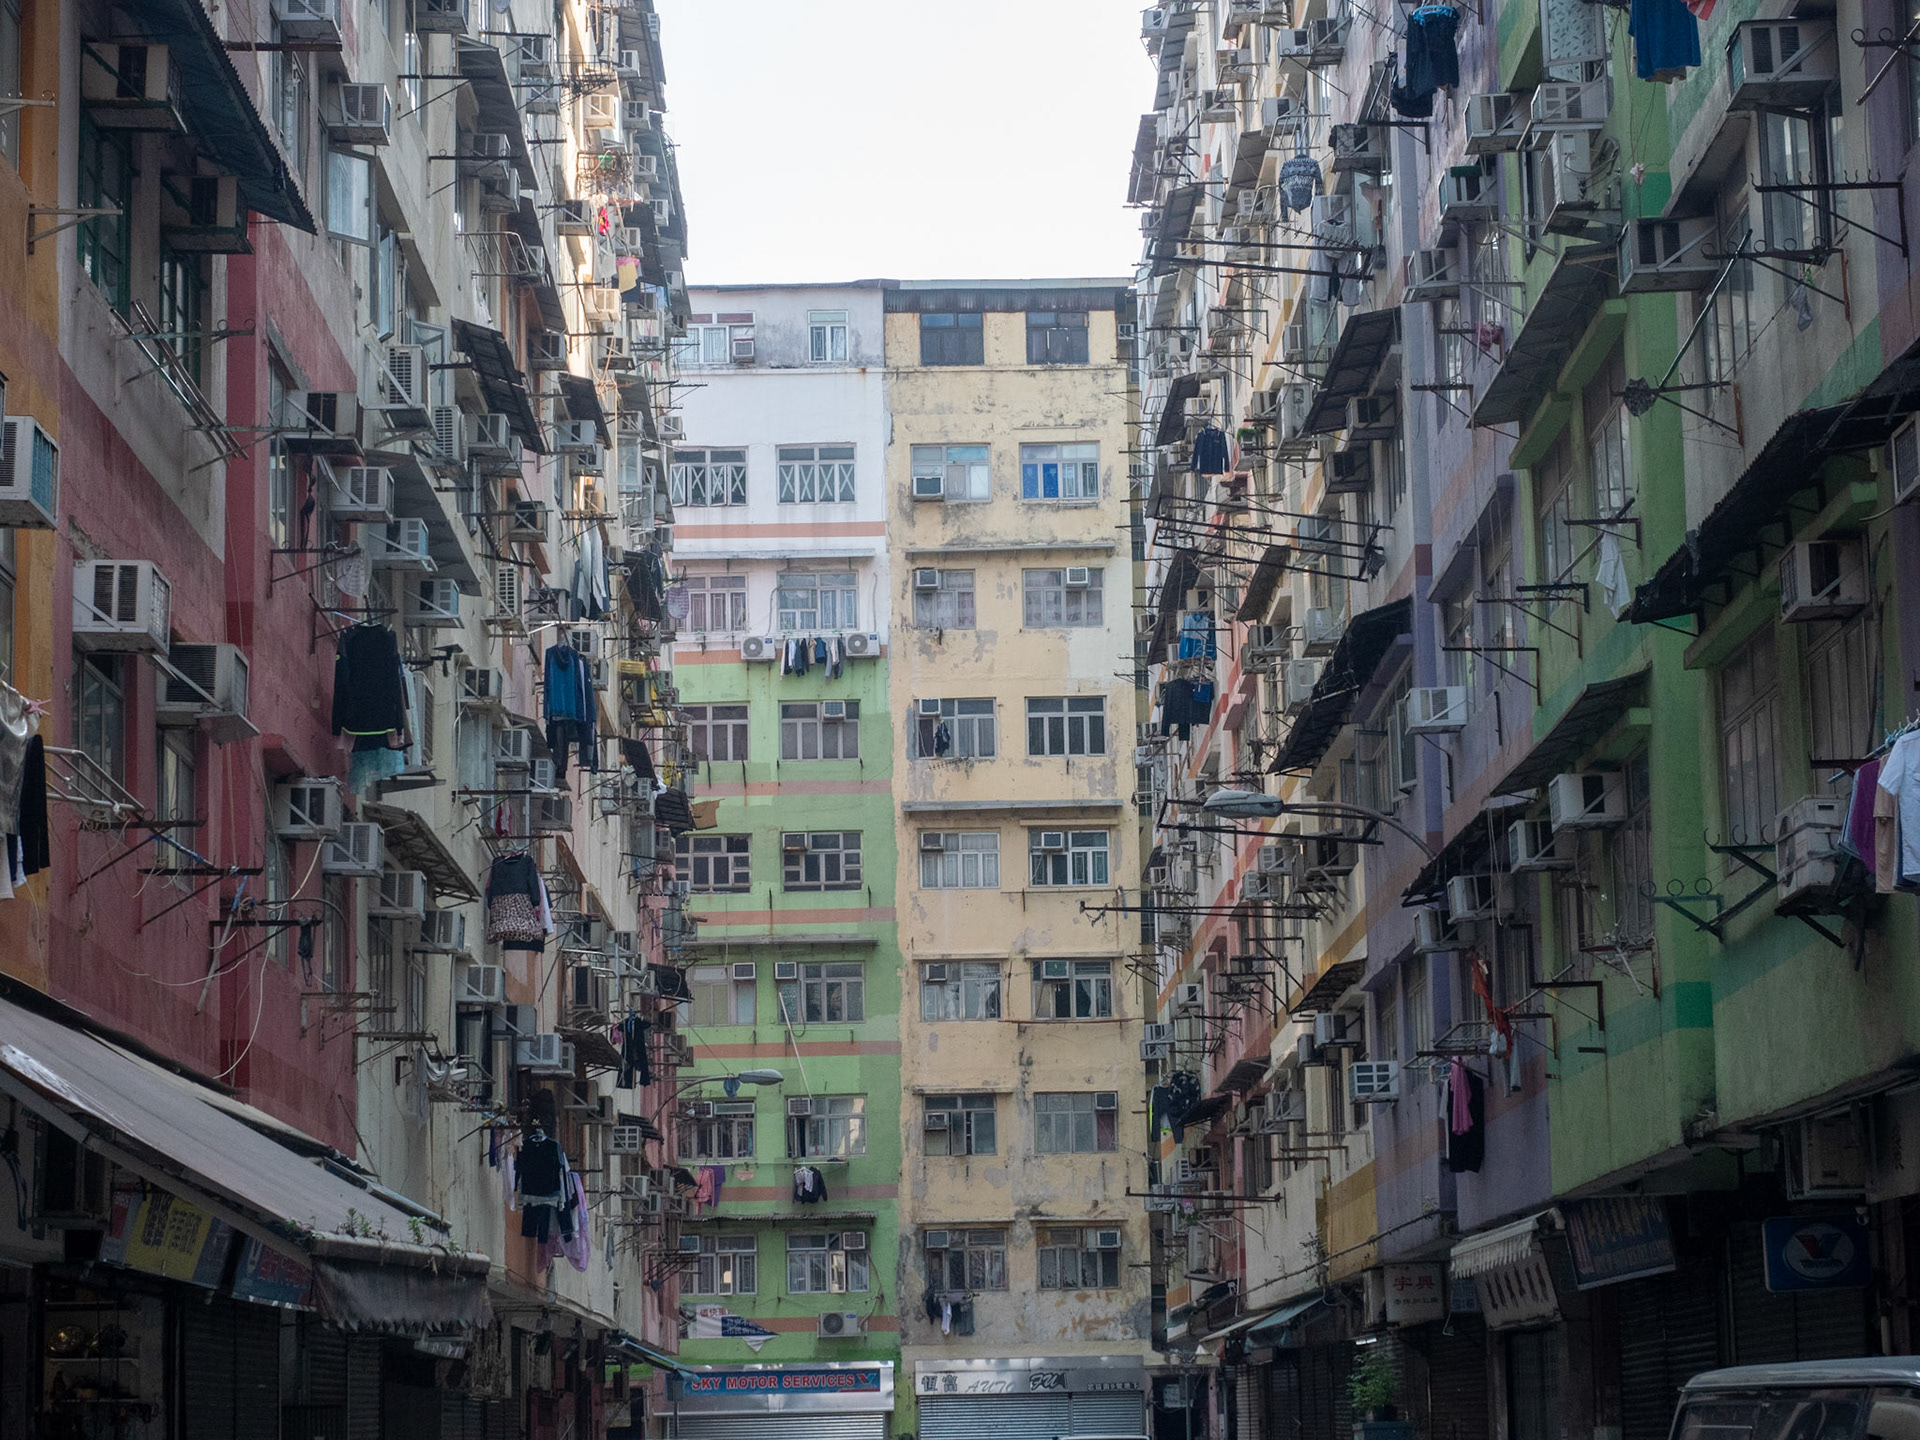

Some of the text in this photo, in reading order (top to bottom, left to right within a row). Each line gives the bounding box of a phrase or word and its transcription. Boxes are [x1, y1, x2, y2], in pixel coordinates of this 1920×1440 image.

[692, 1374, 855, 1389] SKY MOTOR SERVICES
